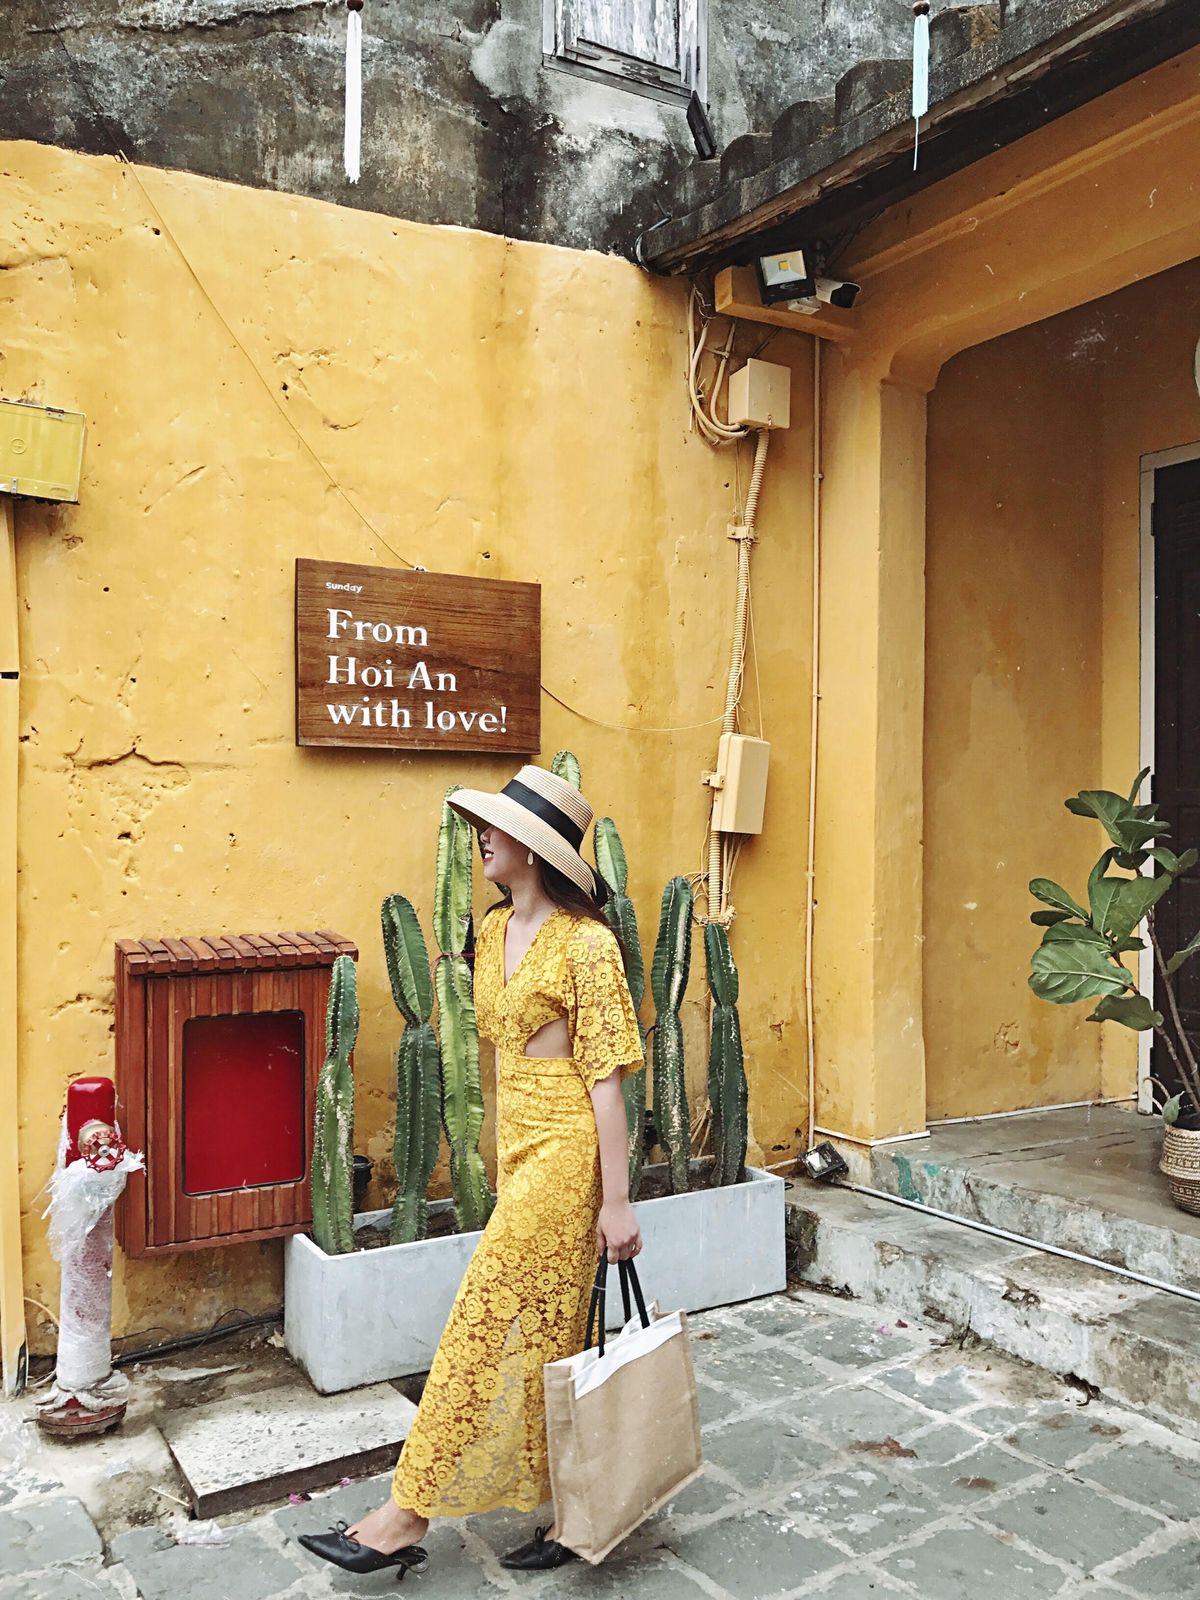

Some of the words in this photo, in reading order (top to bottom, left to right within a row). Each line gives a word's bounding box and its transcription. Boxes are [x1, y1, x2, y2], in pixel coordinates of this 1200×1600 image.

[326, 607, 429, 647] From
[326, 655, 394, 688] Hoi
[407, 661, 458, 692] An
[326, 696, 412, 728] with
[424, 701, 508, 733] love!
